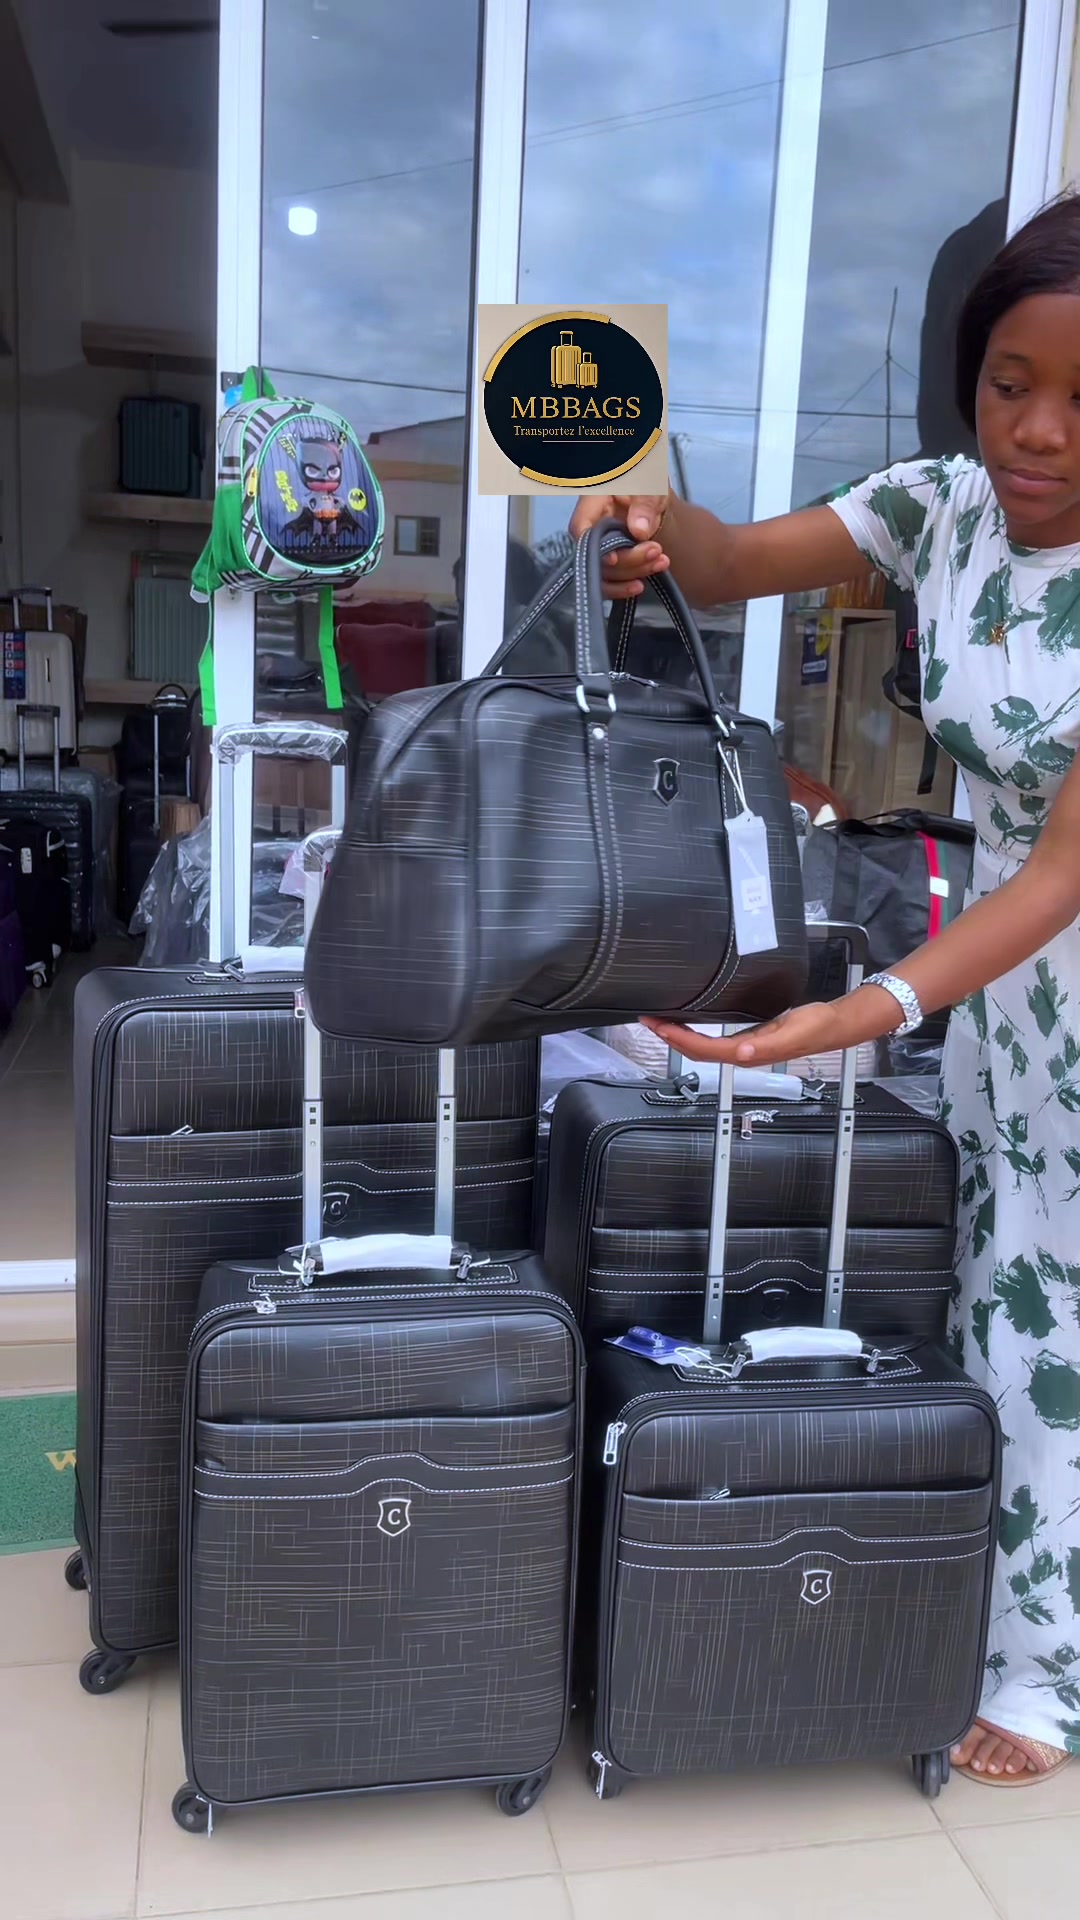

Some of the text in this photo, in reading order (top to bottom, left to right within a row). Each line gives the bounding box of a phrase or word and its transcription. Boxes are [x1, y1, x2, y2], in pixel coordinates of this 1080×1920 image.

[663, 770, 673, 791] C
[330, 1200, 341, 1215] C
[387, 1508, 401, 1525] C
[810, 1579, 823, 1594] C
